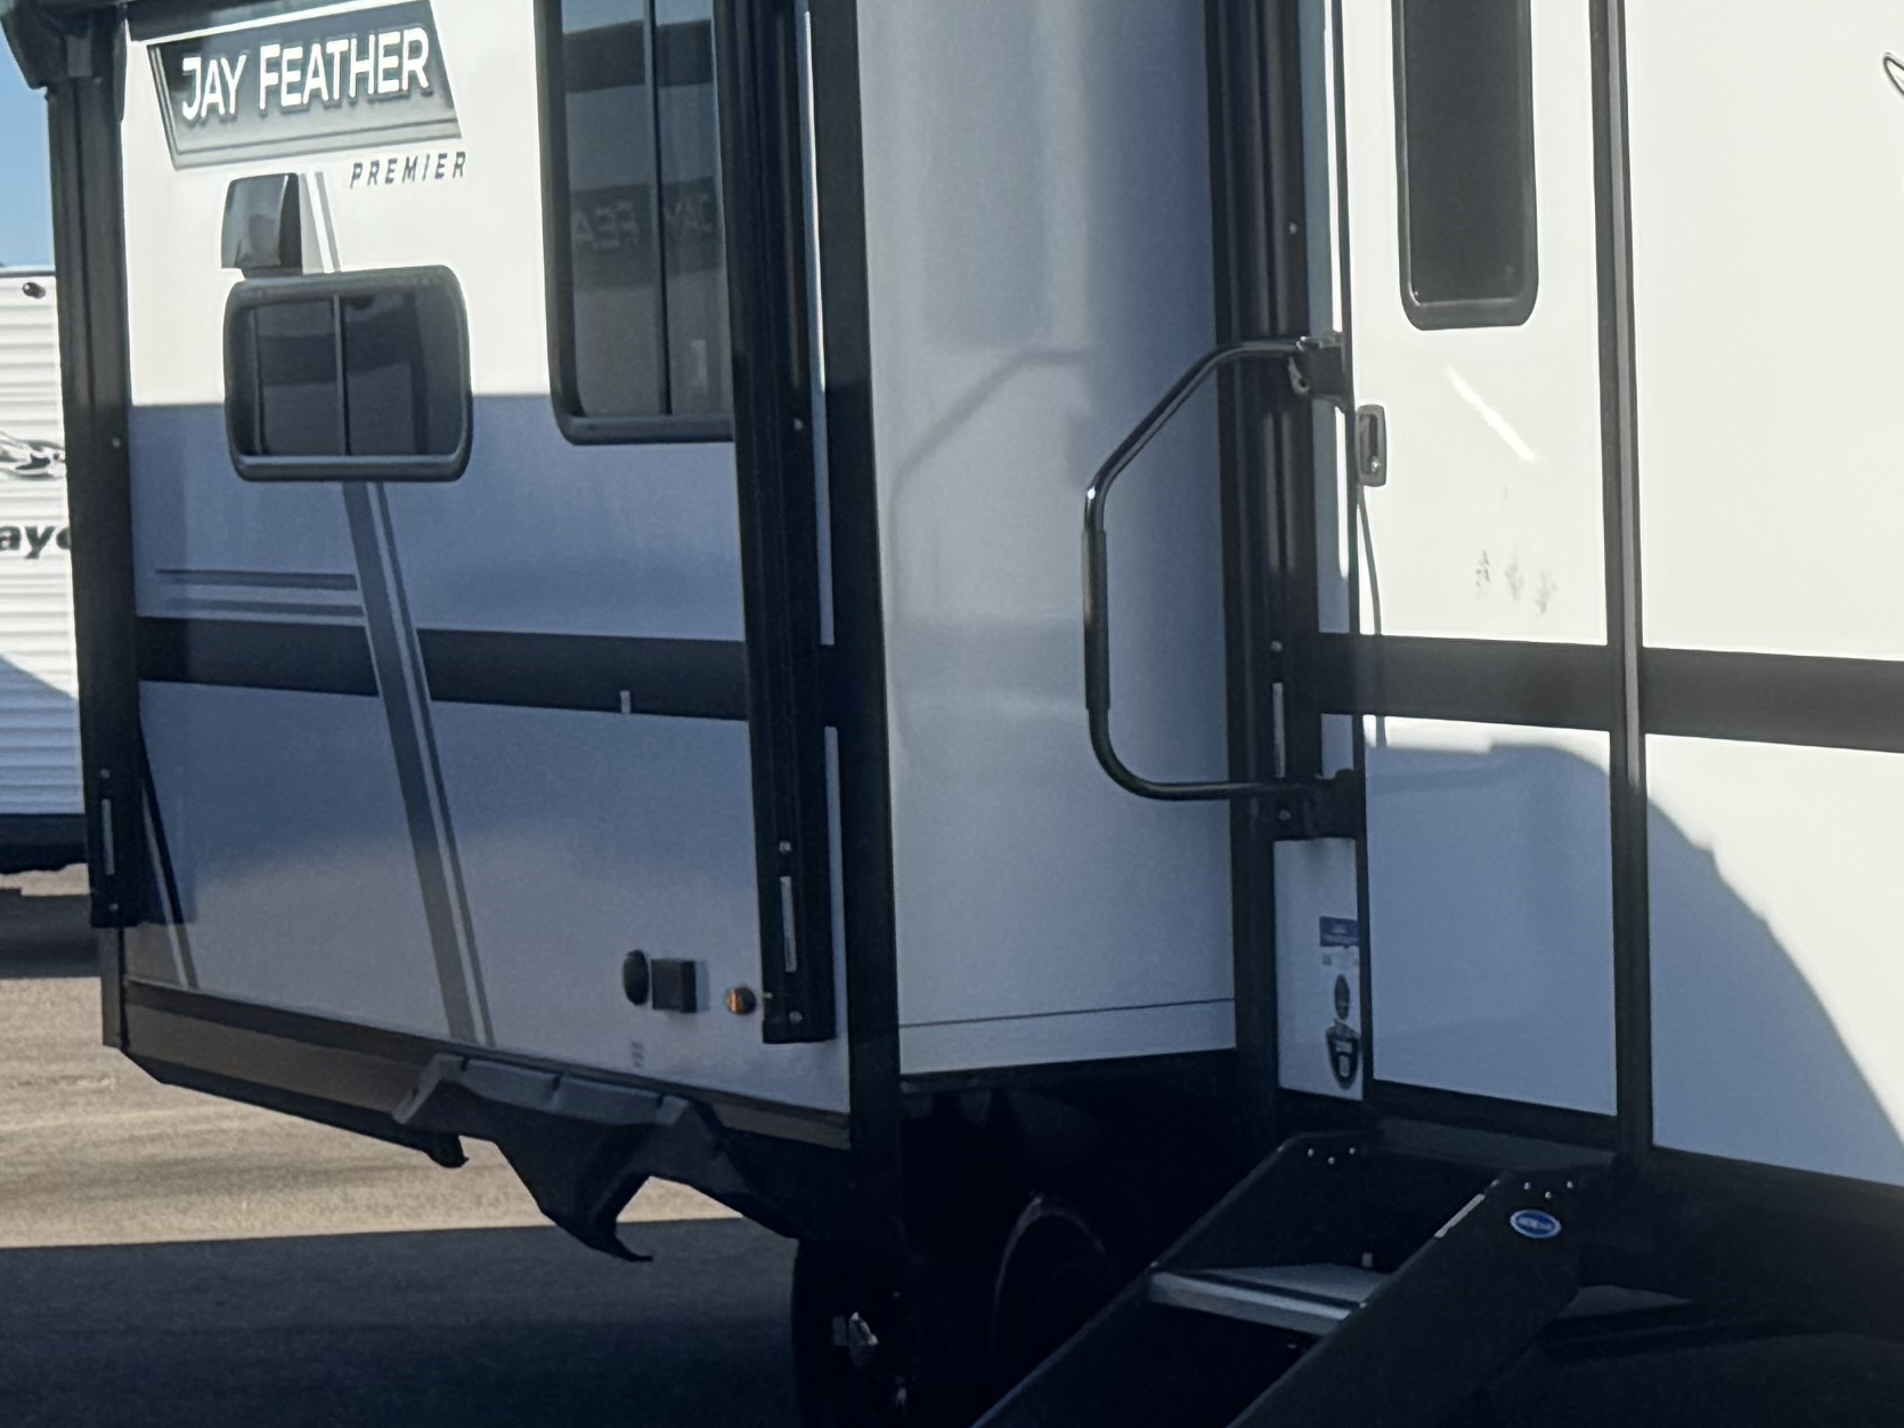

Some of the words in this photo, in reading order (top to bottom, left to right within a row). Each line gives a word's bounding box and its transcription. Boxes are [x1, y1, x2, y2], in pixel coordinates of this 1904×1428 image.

[181, 54, 248, 121] JAY
[258, 27, 431, 113] FEATHER
[350, 151, 466, 189] PREMIER
